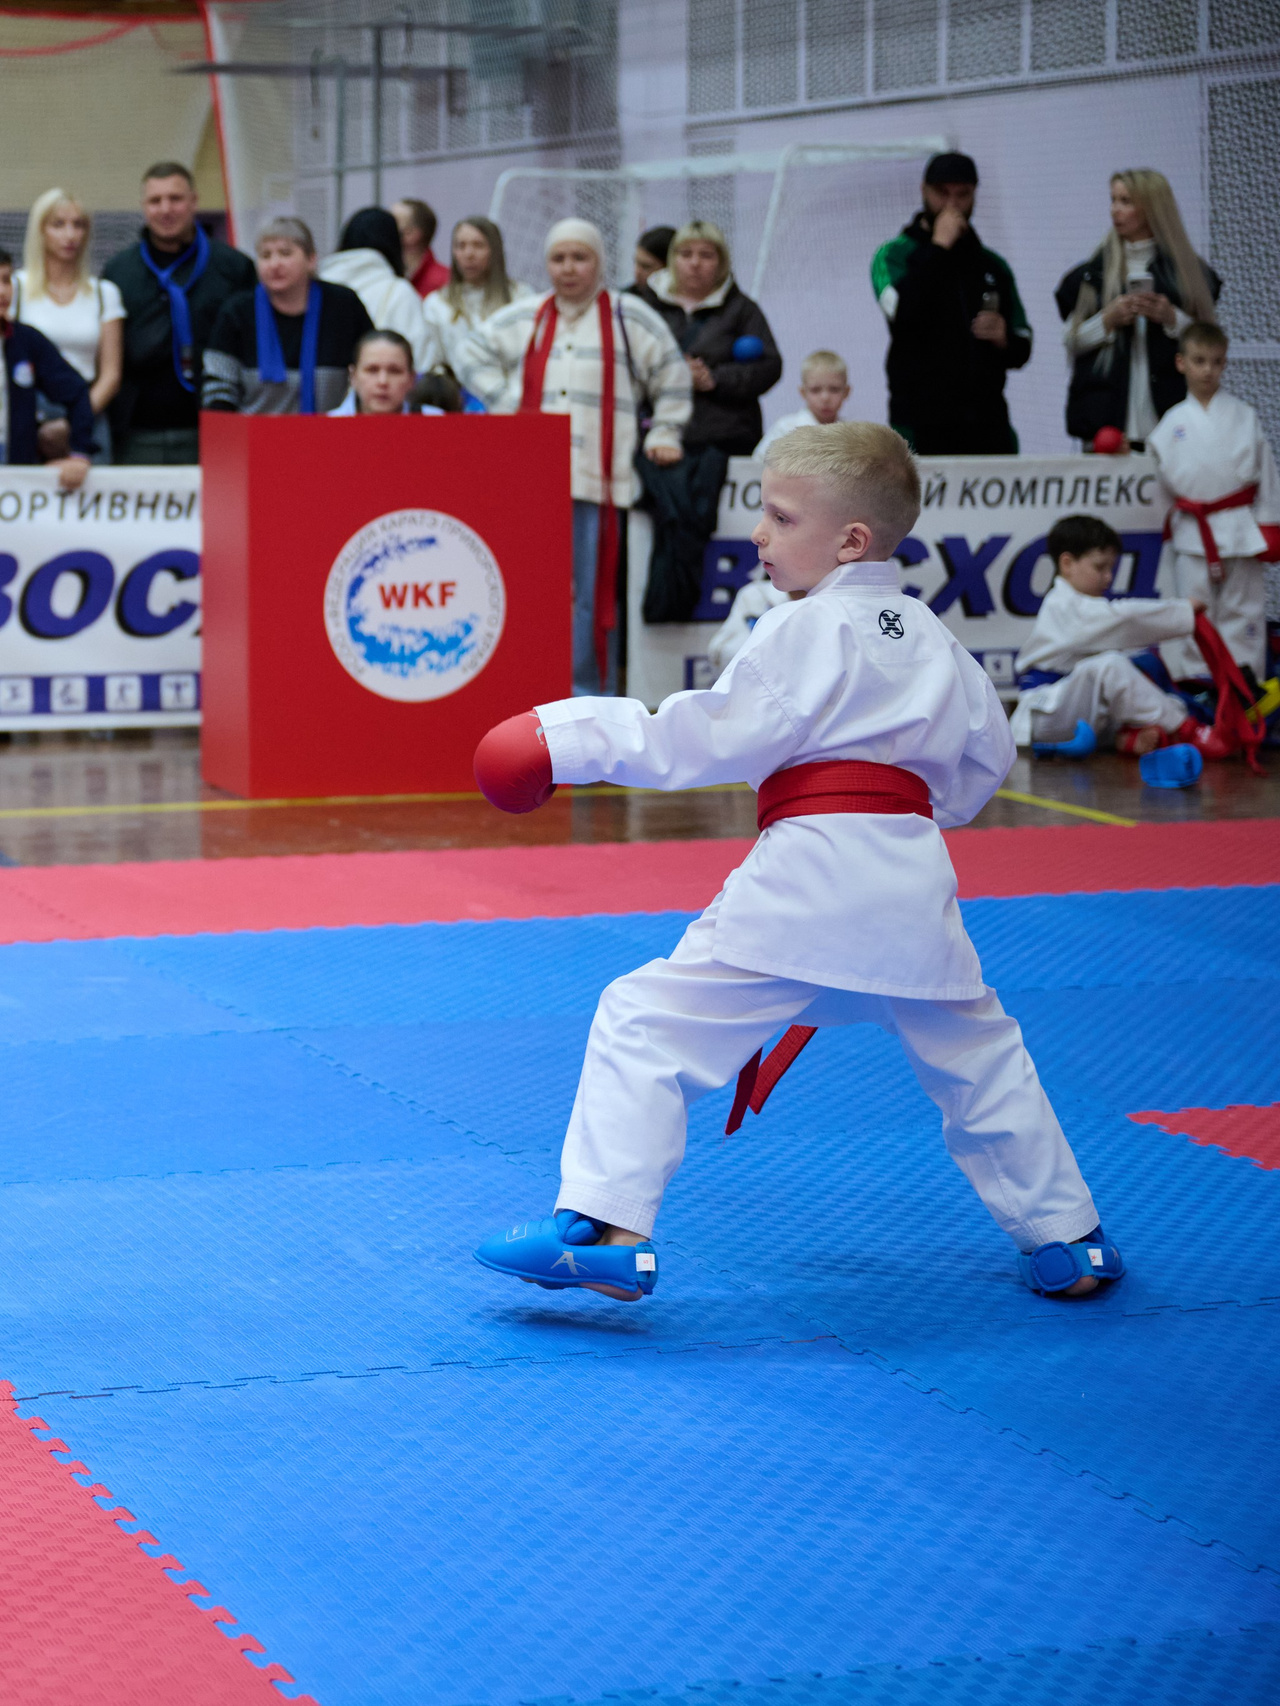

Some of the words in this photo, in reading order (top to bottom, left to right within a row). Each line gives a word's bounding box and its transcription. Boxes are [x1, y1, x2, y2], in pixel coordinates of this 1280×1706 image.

[958, 473, 1157, 508] КОМПЛЕКС
[378, 514, 438, 532] КАРАТЭ
[378, 580, 458, 610] WKF
